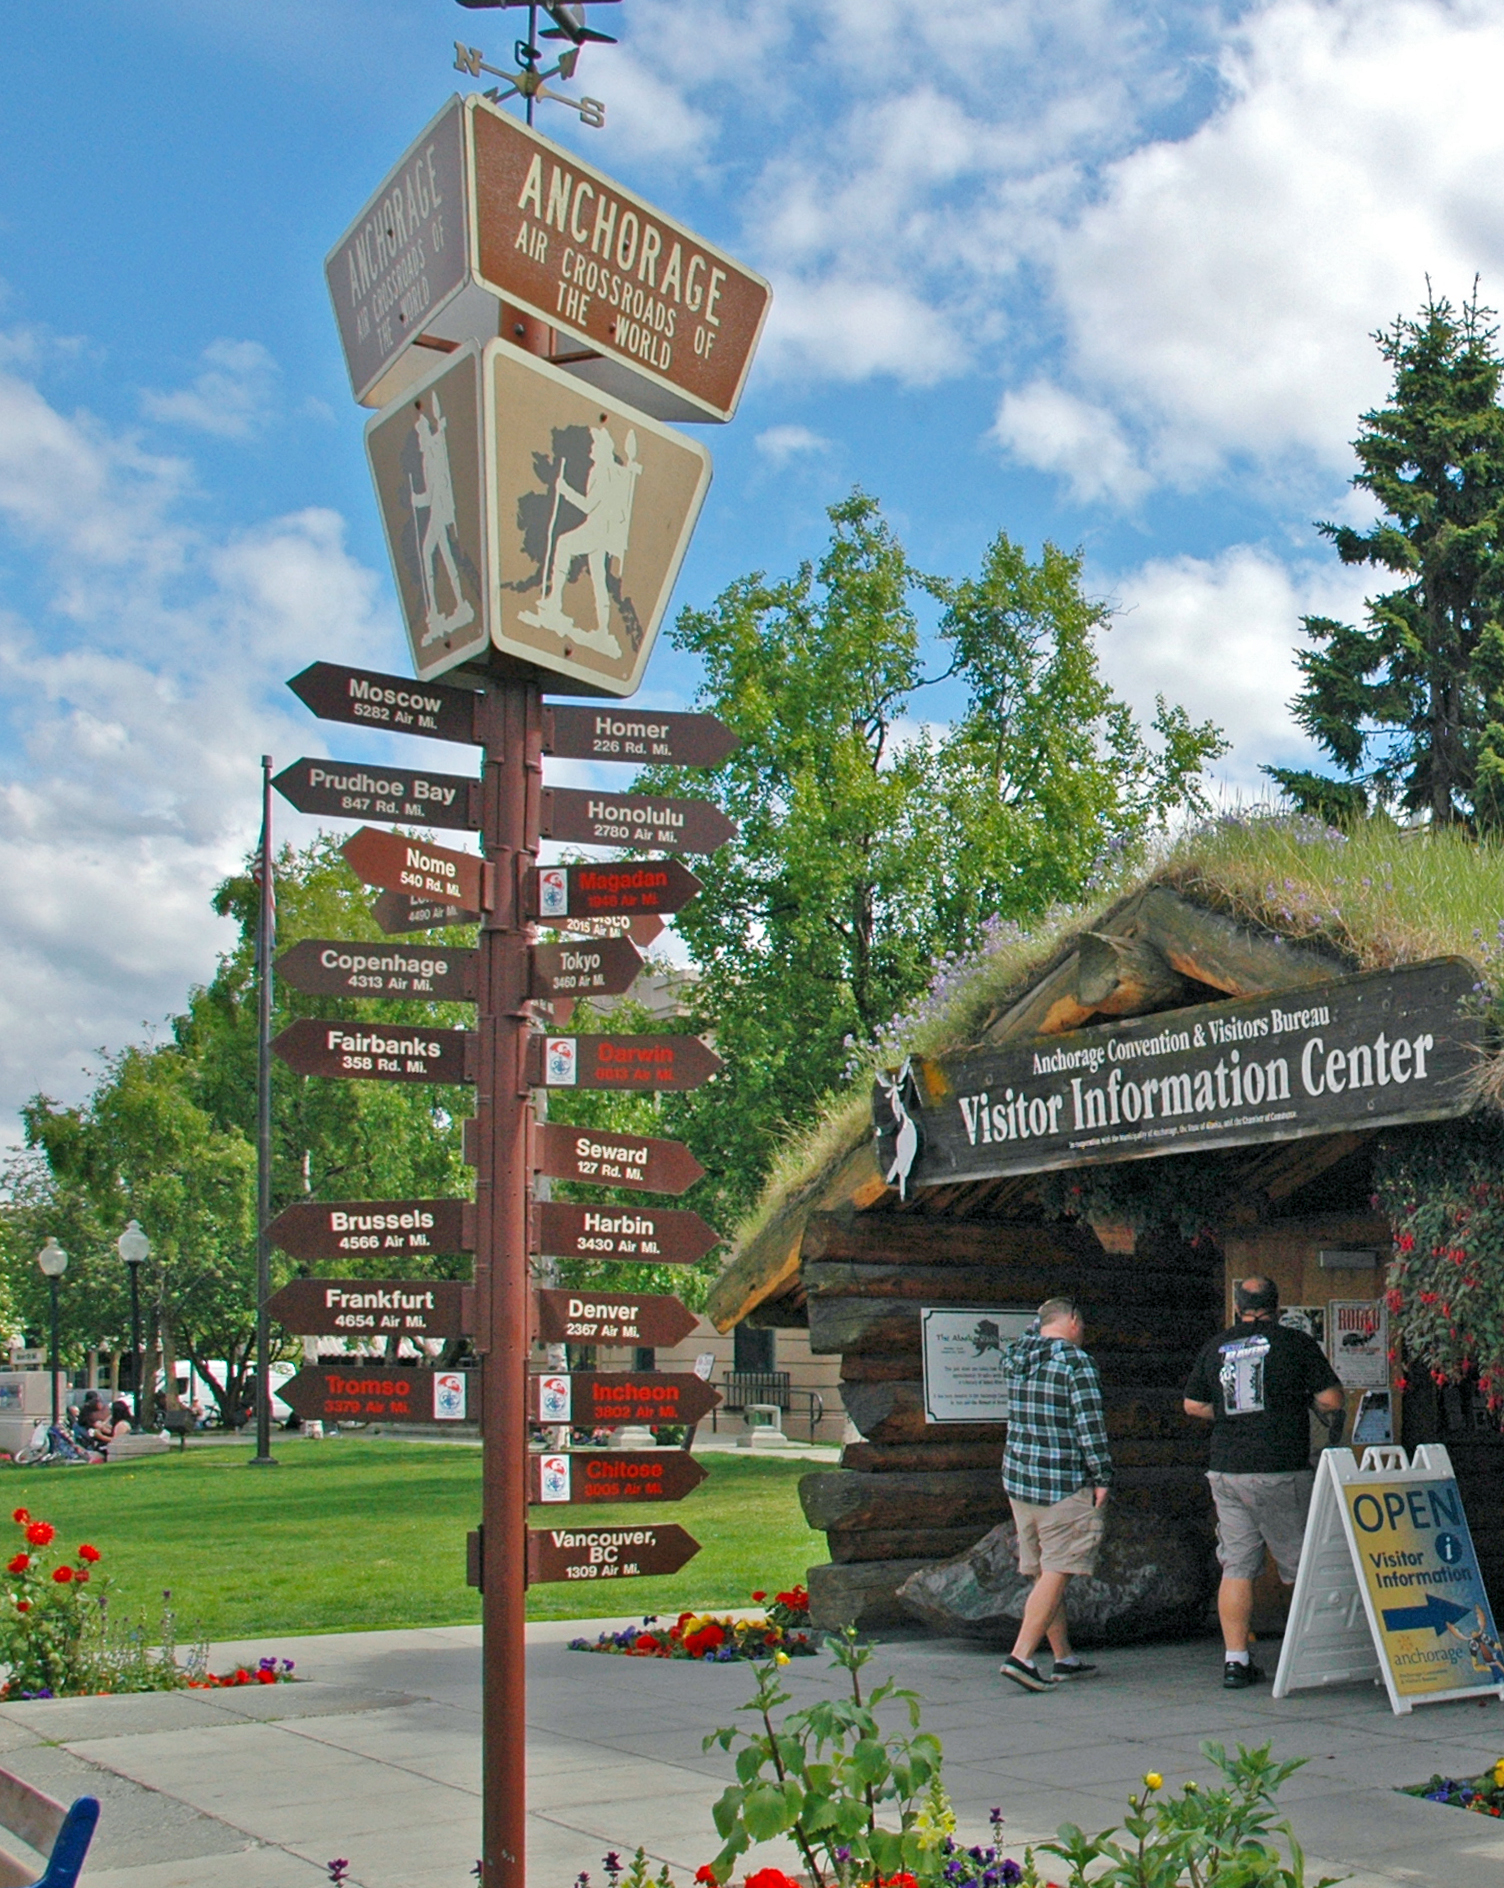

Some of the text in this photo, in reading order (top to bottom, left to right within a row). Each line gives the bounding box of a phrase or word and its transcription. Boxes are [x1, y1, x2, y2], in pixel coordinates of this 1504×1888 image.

[453, 40, 482, 78] N
[580, 96, 605, 128] S
[348, 144, 442, 307] ANCHORAGE
[518, 152, 726, 326] ANCHORAGE
[356, 214, 444, 344] AIR CROSSROADS OF
[514, 221, 716, 359] AIR CROSSROADS OF
[376, 276, 430, 356] THE WORLD
[556, 280, 672, 370] THE WORLD
[349, 678, 442, 713] Moscow
[354, 704, 438, 729] 5282 Air Mi.
[595, 717, 670, 740] Homer
[593, 740, 672, 756] 226 Rd. Mi.
[310, 769, 456, 805] Prudhoe Bay
[342, 796, 425, 817] 847 Rd. Mi.
[588, 801, 684, 827] Honolulu
[594, 824, 678, 844] 2780 Air Mi.
[406, 847, 456, 878] Nome
[400, 870, 461, 898] 540 Rd. Mi.
[579, 870, 668, 892] Magadan
[621, 894, 638, 906] Air
[566, 918, 590, 934] 2015
[593, 924, 607, 936] Air
[320, 950, 448, 977] Copenhage
[560, 952, 600, 972] Tokyo
[348, 975, 434, 992] 4313 Air Mi.
[553, 977, 576, 990] 3460
[578, 976, 591, 987] Air
[328, 1030, 441, 1058] Fairbanks
[1032, 1006, 1330, 1076] Anchorage Convention & Visitors Bureau
[598, 1042, 674, 1062] Darwin
[342, 1056, 427, 1074] 358 Rd. Mi.
[634, 1068, 651, 1080] Air
[958, 1032, 1434, 1146] Visitor Information Center
[576, 1138, 648, 1165] Seward
[577, 1161, 644, 1181] 127 Rd. Mi.
[331, 1210, 434, 1232] Brussels
[584, 1212, 654, 1236] Harbin
[340, 1233, 430, 1250] 4566 Air Mi.
[577, 1238, 660, 1254] 3430 Air Mi.
[326, 1289, 434, 1310] Frankfurt
[335, 1314, 426, 1328] 4654 Air Mi.
[568, 1300, 638, 1321] Denver
[566, 1323, 640, 1338] 2367 Air Mi.
[324, 1374, 410, 1396] Tromso
[592, 1382, 680, 1401] Incheon
[365, 1401, 385, 1414] Air
[594, 1405, 678, 1418] 3802 Air Mi.
[586, 1460, 664, 1479] Chitose
[624, 1483, 642, 1495] Air
[1353, 1488, 1462, 1533] OPEN
[552, 1530, 656, 1549] Vancouver,
[589, 1547, 618, 1563] BC
[1369, 1552, 1424, 1569] Visitor
[566, 1562, 640, 1578] 1309 Air Mi.
[1376, 1566, 1472, 1589] Information
[1394, 1648, 1463, 1665] anchorage
